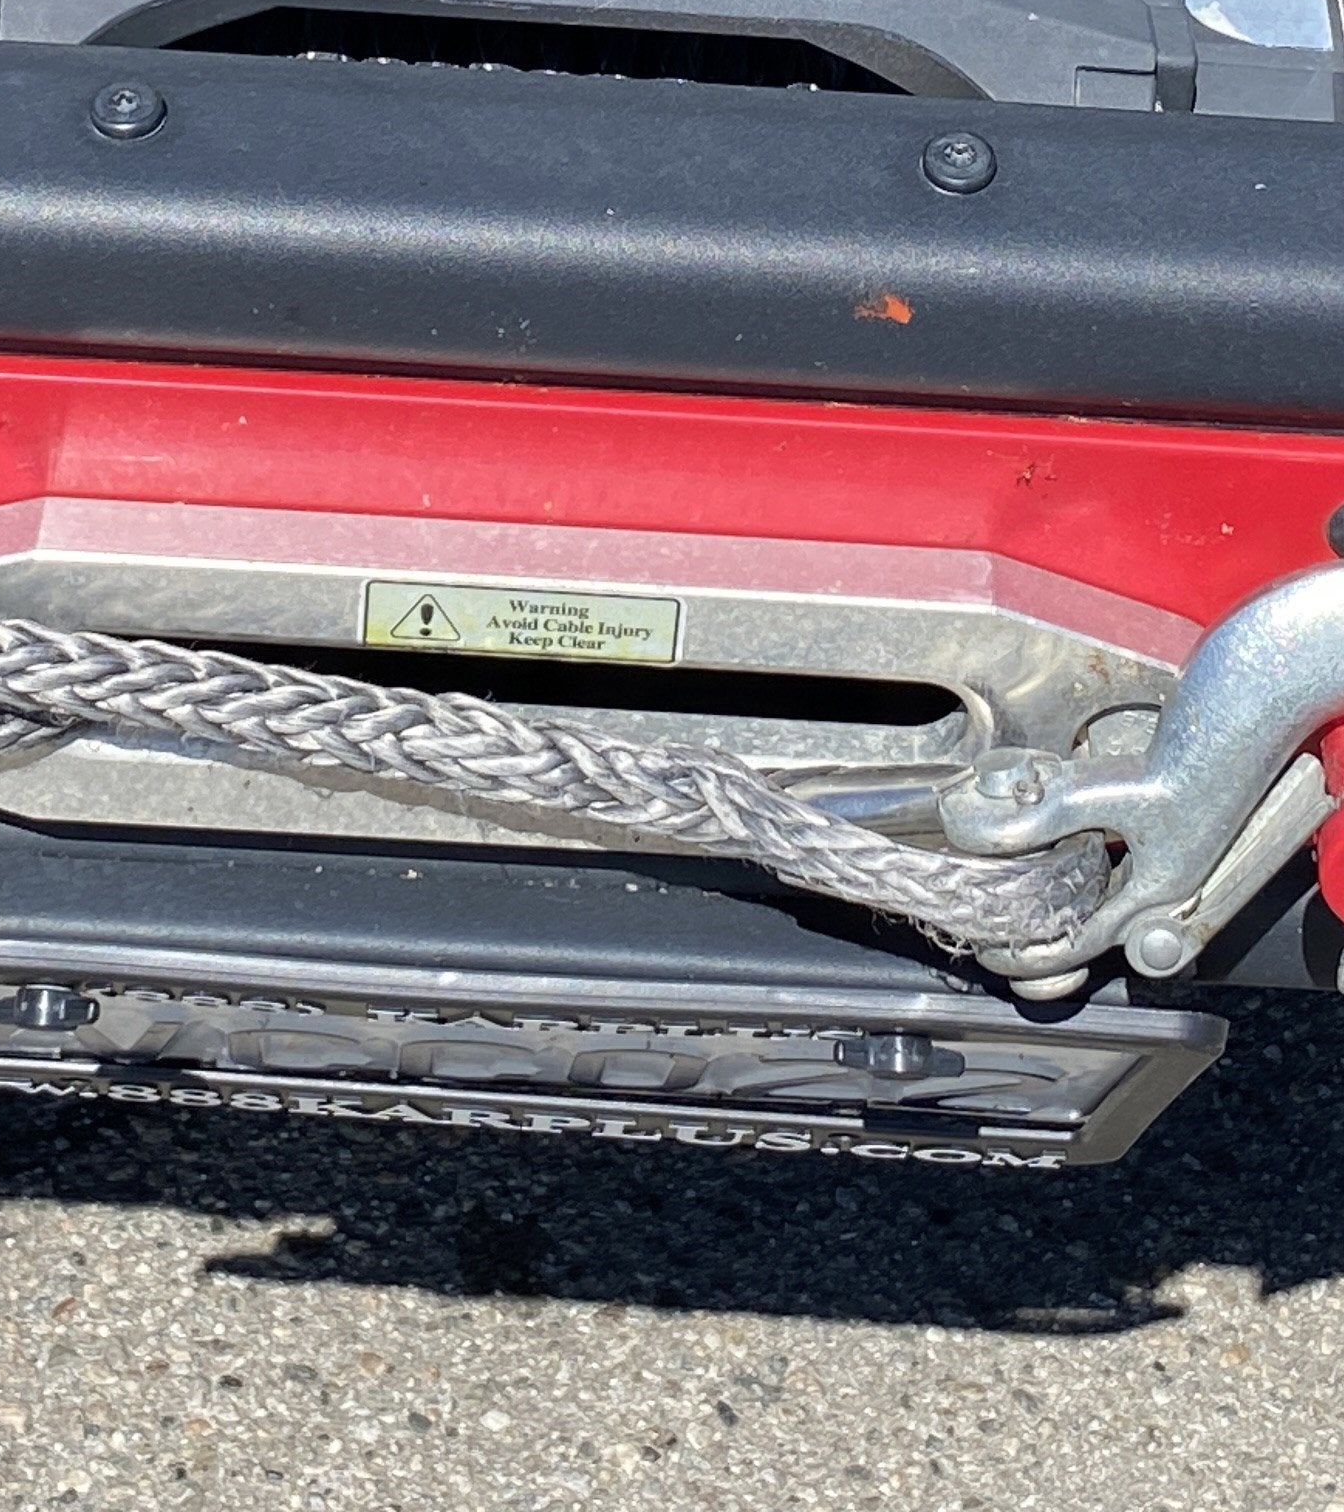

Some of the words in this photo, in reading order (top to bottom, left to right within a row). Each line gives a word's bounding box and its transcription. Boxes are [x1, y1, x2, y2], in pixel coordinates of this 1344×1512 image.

[509, 599, 590, 619] Warning
[486, 616, 538, 630] Avoid
[543, 618, 593, 634] Cable
[598, 621, 653, 641] Injury
[509, 631, 553, 649] Keep
[558, 635, 606, 650] Clear
